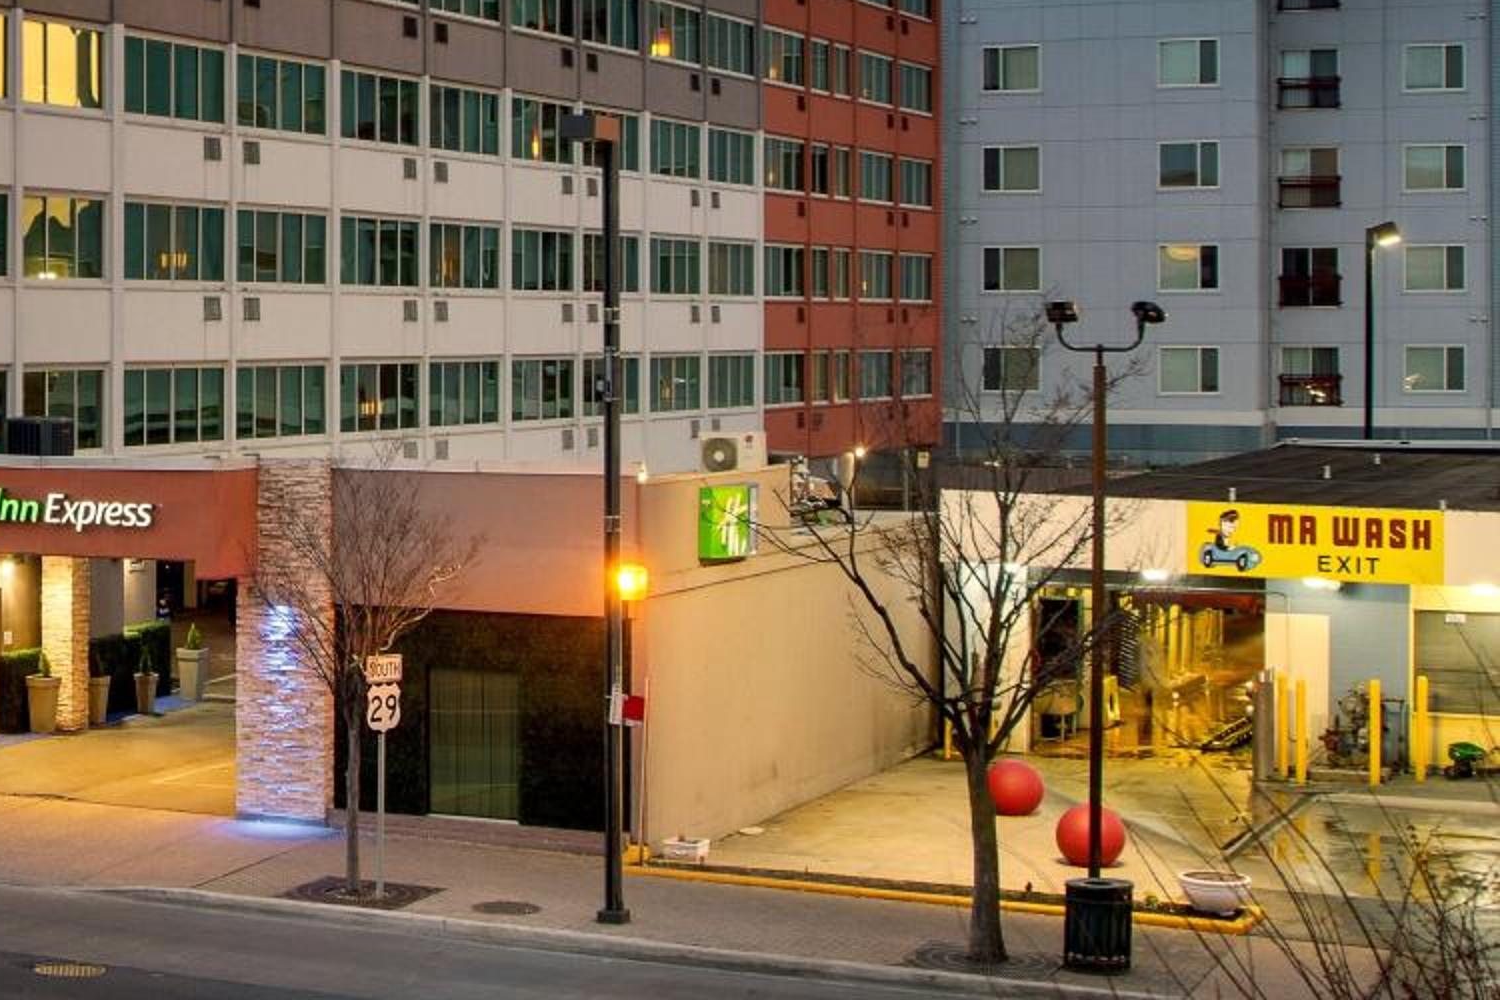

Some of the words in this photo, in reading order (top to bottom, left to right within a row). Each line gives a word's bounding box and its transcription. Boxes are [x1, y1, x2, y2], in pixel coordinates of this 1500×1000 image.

[42, 493, 153, 533] Express
[1332, 516, 1432, 550] WASH
[1317, 555, 1381, 575] EXIT
[369, 661, 400, 677] SOUTH
[370, 694, 396, 722] 29
